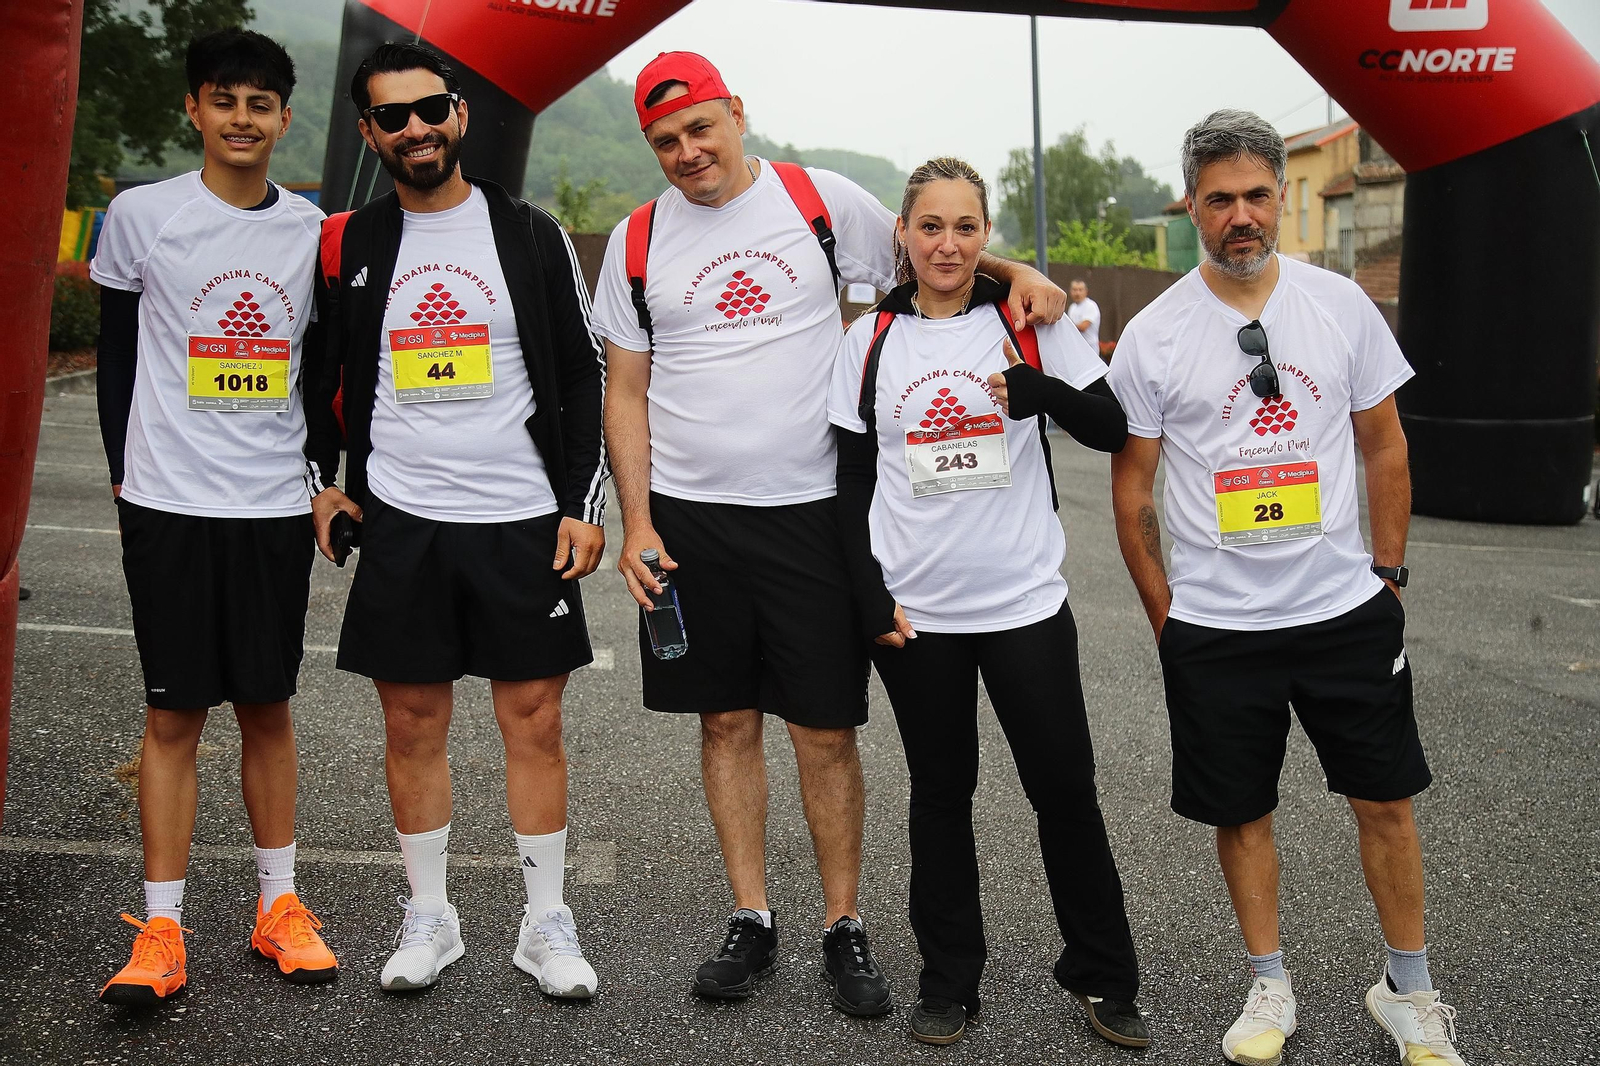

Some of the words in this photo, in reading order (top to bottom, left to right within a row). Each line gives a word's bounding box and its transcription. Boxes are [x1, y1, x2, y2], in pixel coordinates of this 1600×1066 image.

[511, 0, 620, 17] RTE
[1358, 46, 1517, 73] CCNORTE
[1456, 74, 1494, 83] EVENTS
[390, 263, 441, 295] ANDAINA
[445, 264, 498, 306] CAMPEIRA
[683, 290, 695, 305] III
[691, 250, 741, 288] ANDAINA
[744, 249, 798, 284] CAMPEIRA
[190, 296, 203, 313] III
[200, 269, 251, 297] ANDAINA
[255, 272, 295, 323] CAMPEIRA
[407, 334, 424, 344] GSI
[209, 343, 227, 353] GSI
[417, 350, 455, 360] SANCHEZ
[455, 349, 463, 357] M
[219, 361, 257, 370] SANCHEZ
[258, 362, 263, 370] J
[427, 362, 456, 380] 44
[213, 373, 269, 392] 1018
[1222, 405, 1232, 420] III
[1228, 373, 1251, 403] ANDA
[1277, 362, 1322, 402] CAMPEIRA
[893, 404, 902, 419] III
[900, 369, 949, 402] ANDAINA
[931, 440, 978, 453] CABANELAS
[1239, 441, 1283, 458] Facendo
[935, 452, 978, 472] 243
[1233, 476, 1250, 485] GSI
[1256, 490, 1278, 499] JACK
[1253, 503, 1284, 522] 28
